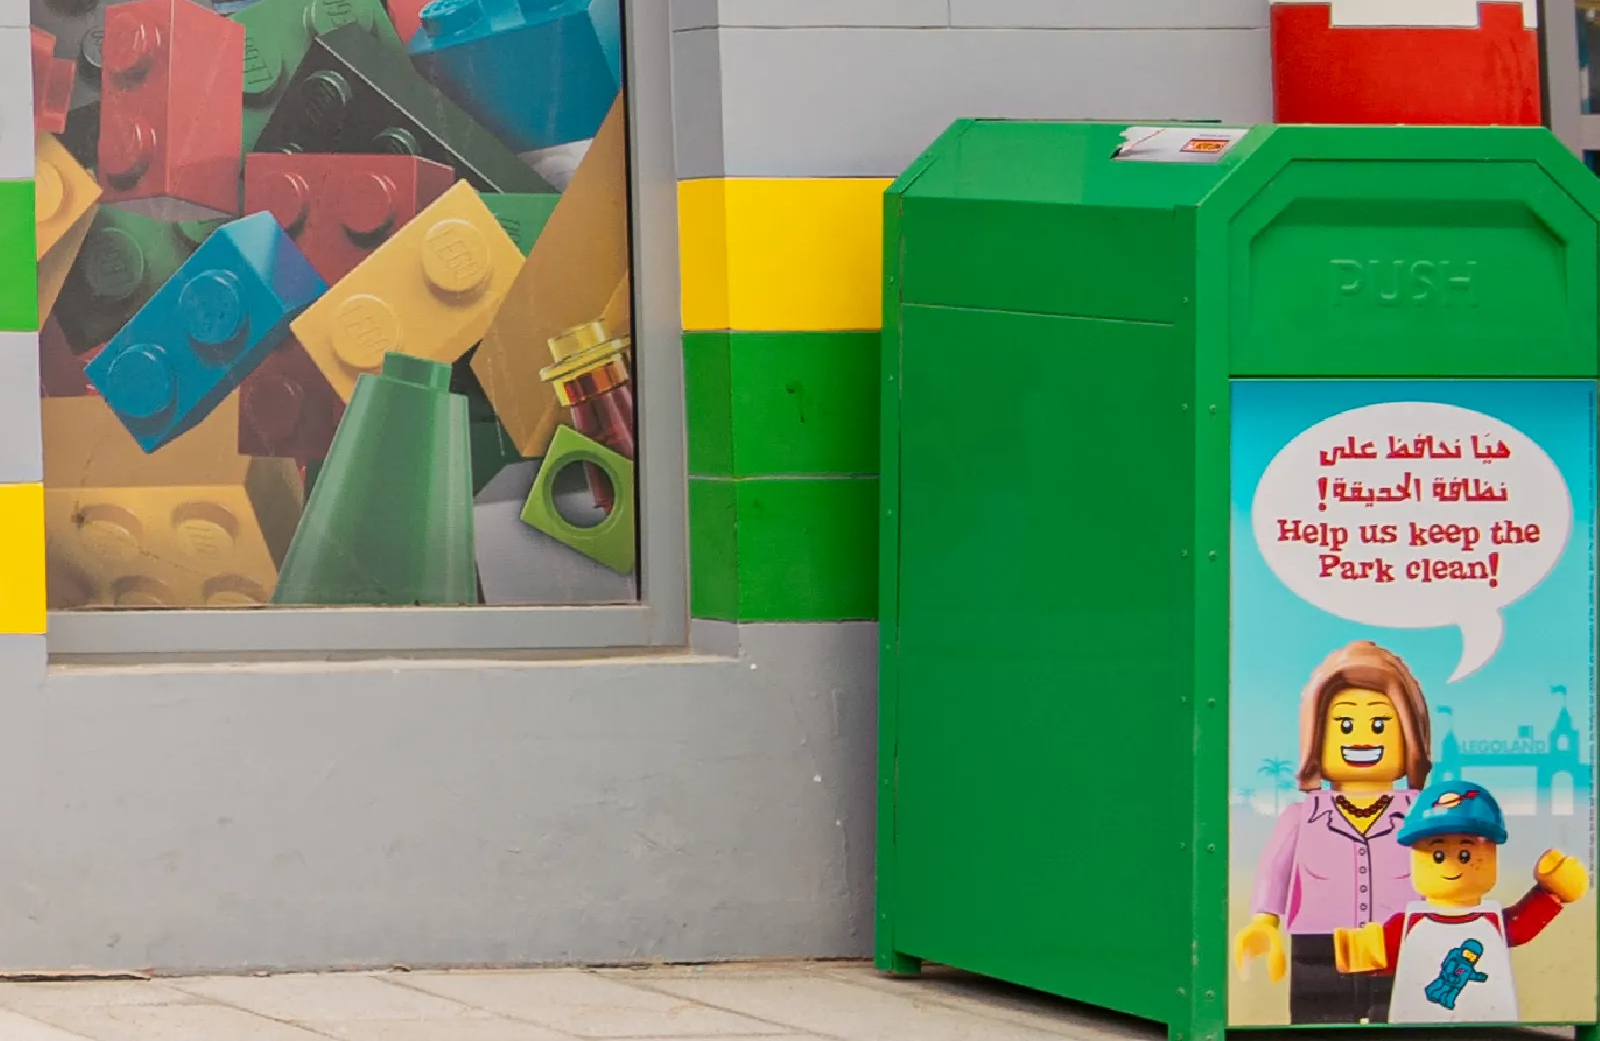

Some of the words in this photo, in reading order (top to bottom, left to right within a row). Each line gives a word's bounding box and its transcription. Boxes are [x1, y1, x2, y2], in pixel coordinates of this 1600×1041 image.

[430, 226, 478, 281] LEGO
[1329, 259, 1480, 308] PUSH
[1319, 436, 1378, 467] على
[1385, 432, 1462, 459] نحافظ
[1432, 477, 1509, 502] نظافة
[1277, 519, 1349, 551] Help
[1359, 524, 1398, 544] us
[1409, 522, 1480, 551] keep
[1490, 520, 1541, 544] the
[1319, 554, 1396, 583] Park
[1406, 552, 1500, 588] clean!
[1461, 739, 1547, 755] LEGOLAND
